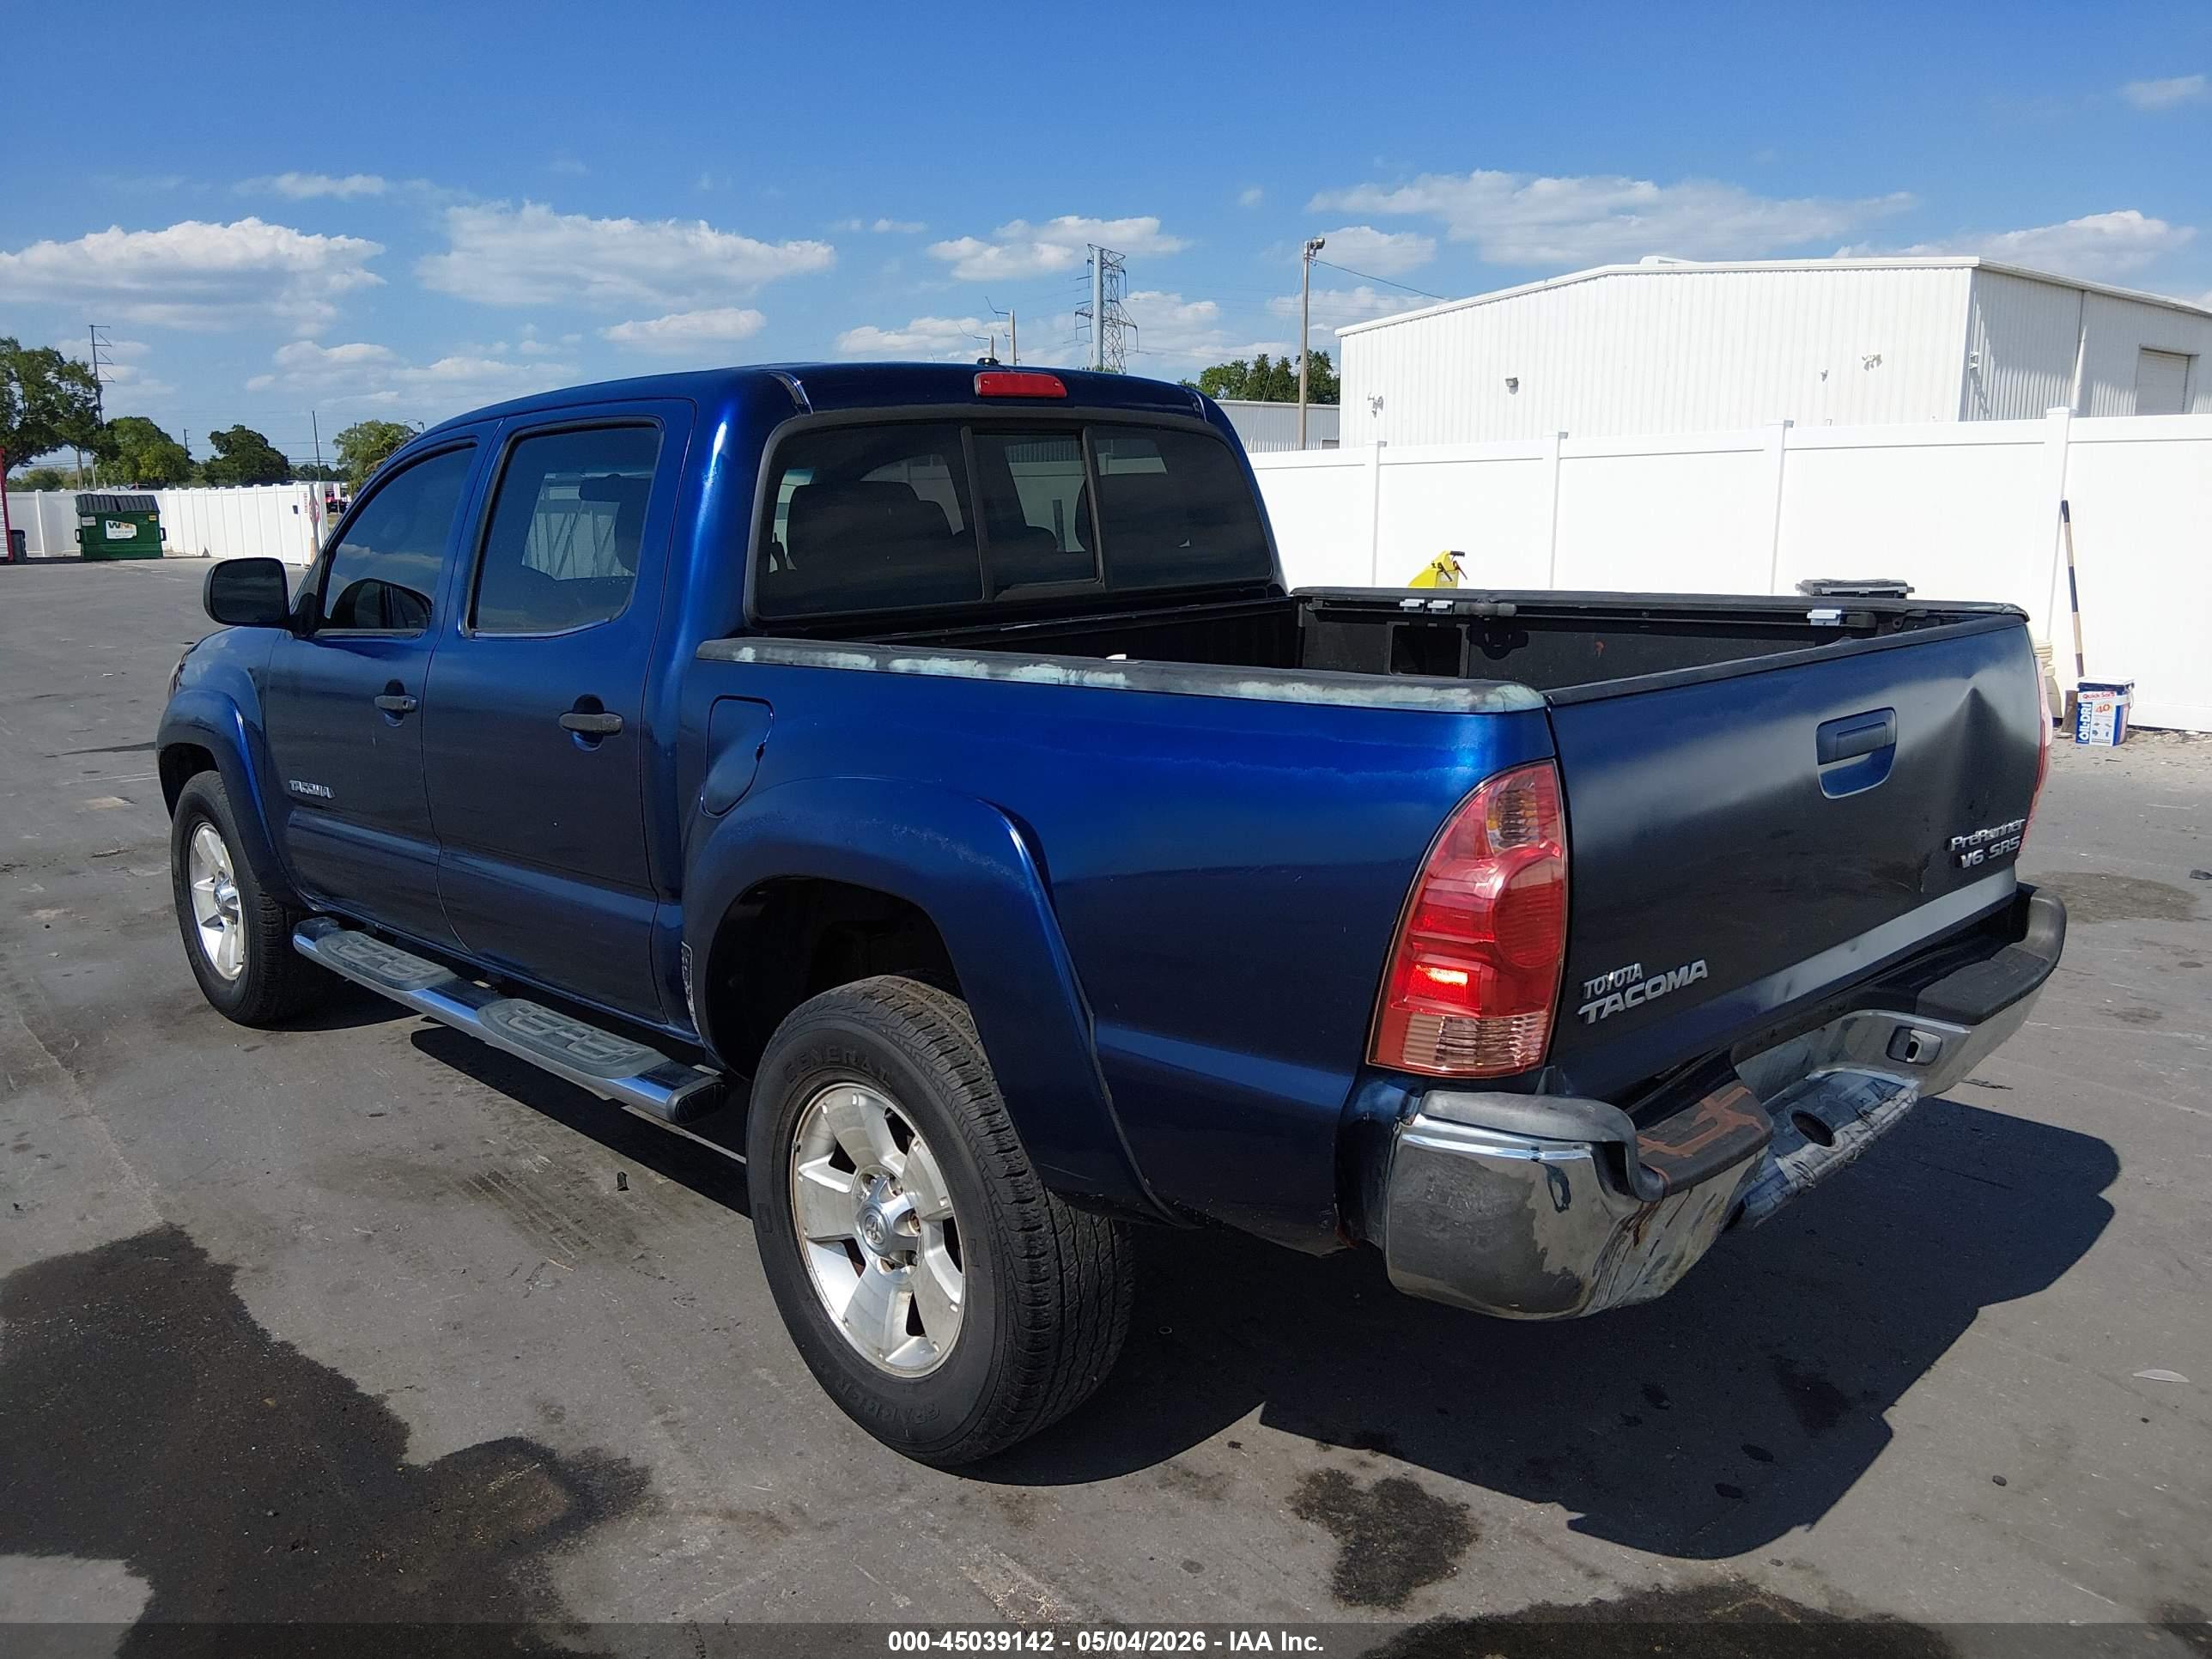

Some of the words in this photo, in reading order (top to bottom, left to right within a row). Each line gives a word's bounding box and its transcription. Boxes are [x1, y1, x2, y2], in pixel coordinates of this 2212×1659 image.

[1960, 849, 1984, 868] V6
[1988, 836, 2021, 859] SR5
[1577, 959, 1709, 1024] TACOMA
[1583, 963, 1644, 1000] TOYOTA
